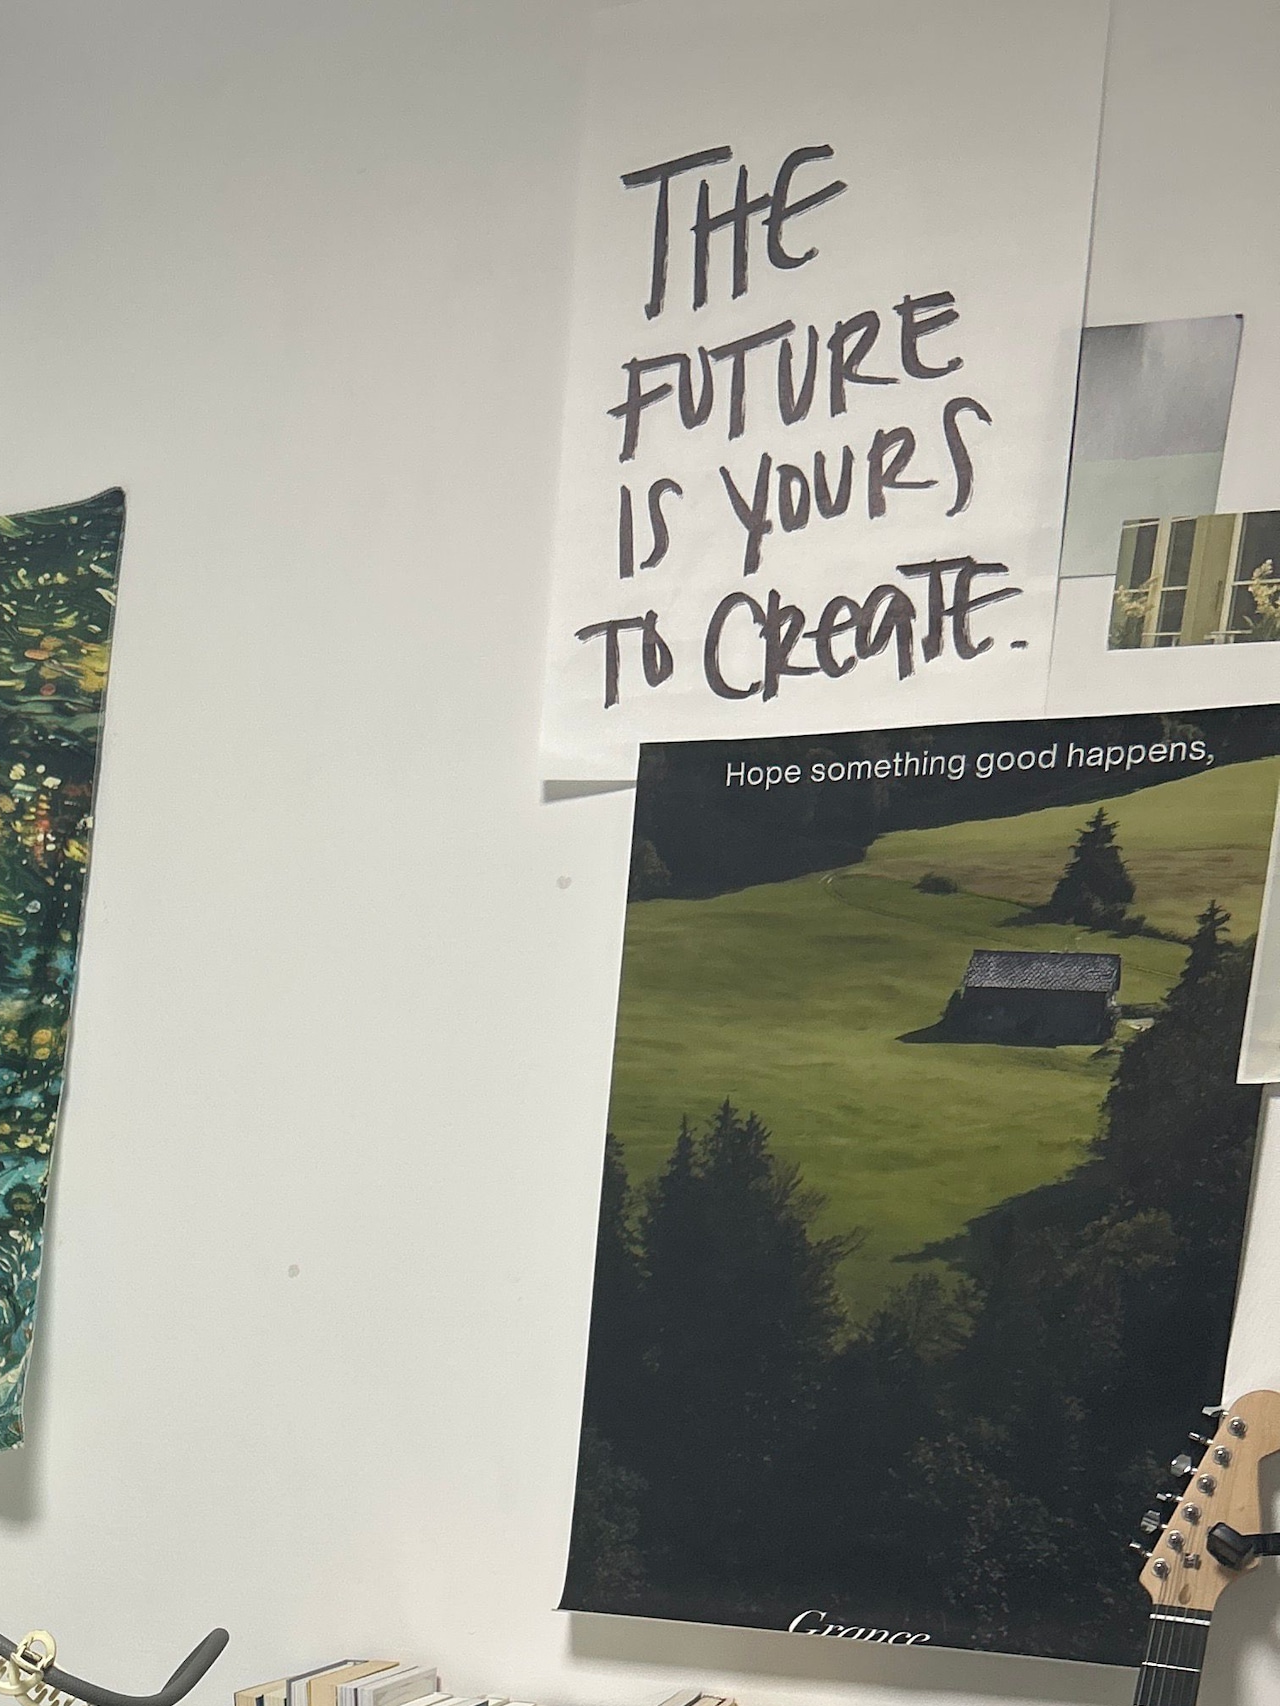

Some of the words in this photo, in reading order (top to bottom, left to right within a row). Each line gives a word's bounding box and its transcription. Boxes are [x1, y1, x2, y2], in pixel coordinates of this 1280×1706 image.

[620, 144, 848, 321] THE
[607, 291, 964, 463] FUTURE
[618, 477, 684, 580] IS
[719, 397, 993, 578] YOURS
[574, 609, 675, 710] TO
[725, 761, 801, 790] Hope
[810, 749, 966, 783] something
[975, 743, 1058, 779] good
[1066, 738, 1216, 772] happens,
